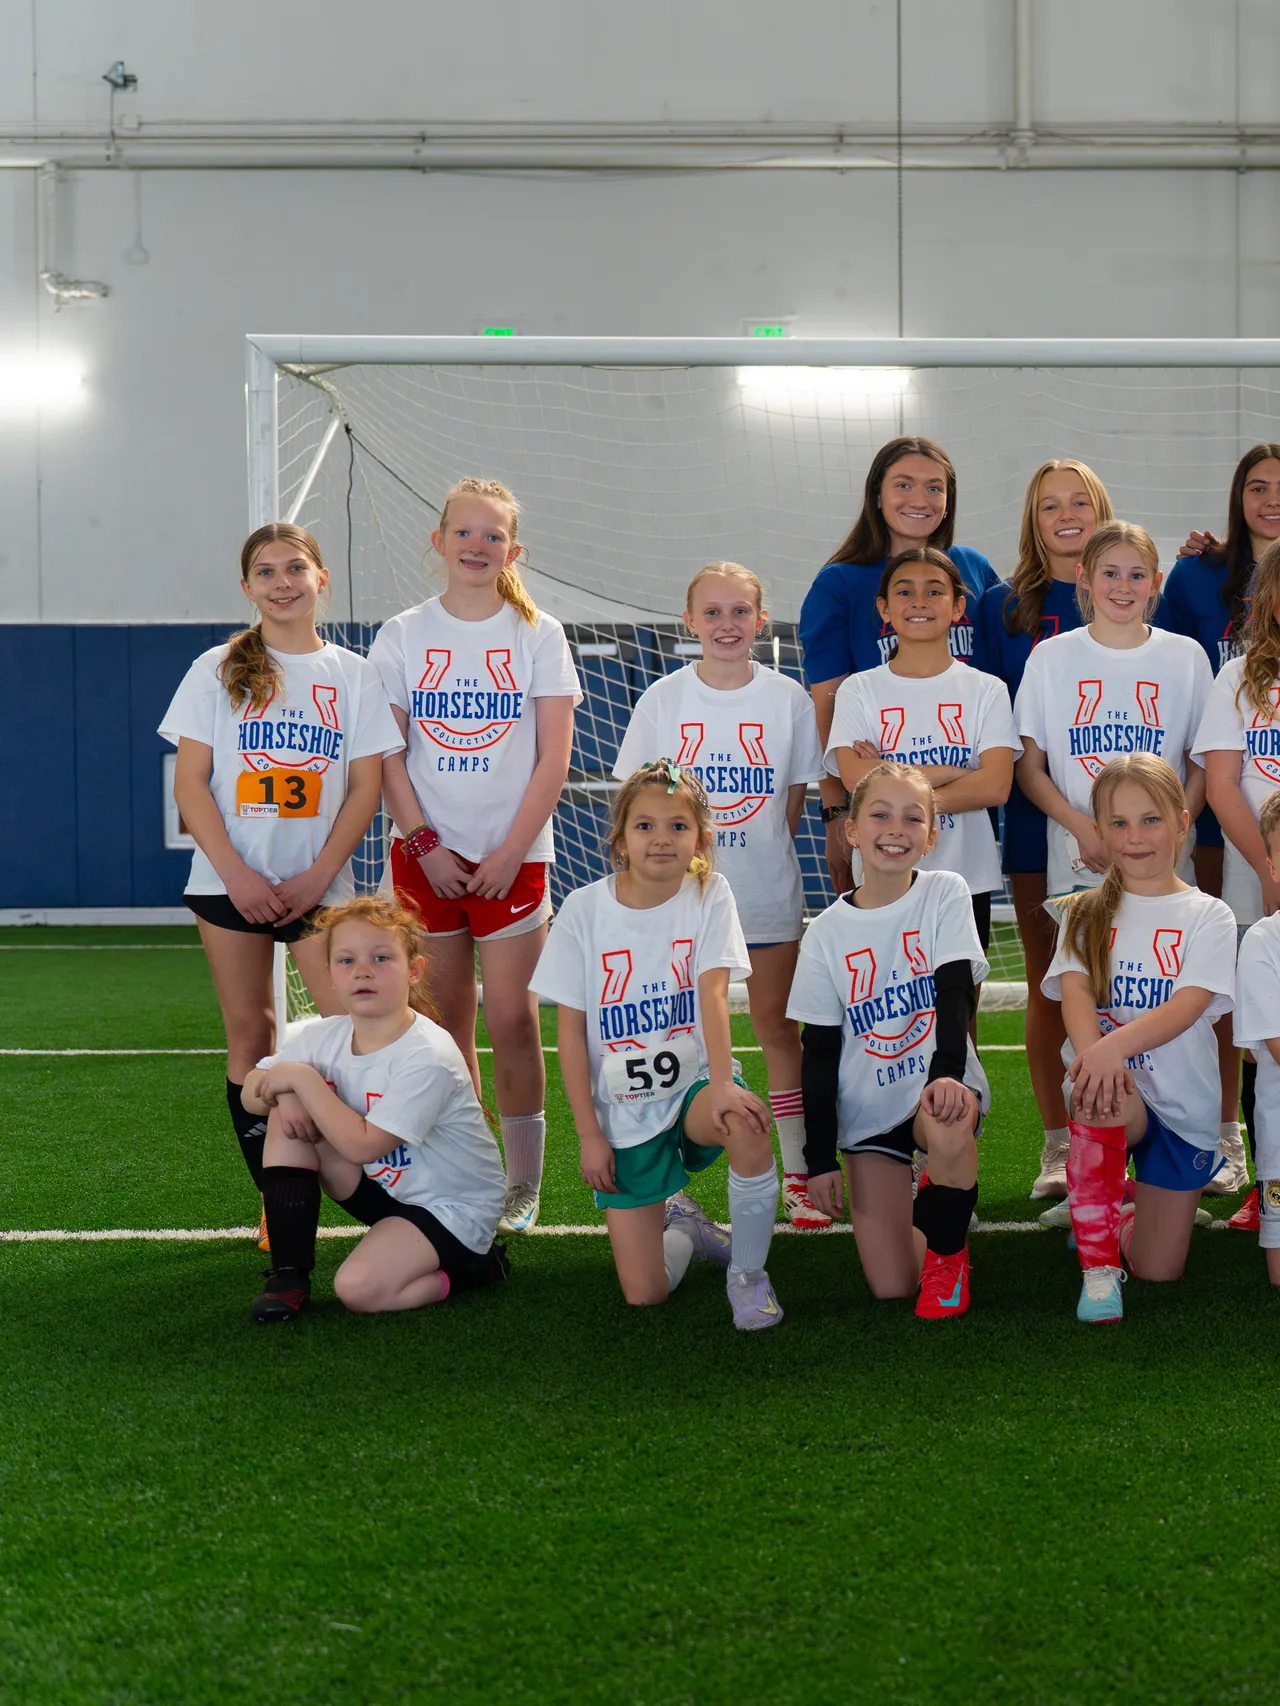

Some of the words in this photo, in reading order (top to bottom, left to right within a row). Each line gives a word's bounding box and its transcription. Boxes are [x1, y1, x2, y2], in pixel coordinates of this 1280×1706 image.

[456, 678, 478, 687] THE
[281, 708, 305, 719] THE
[411, 690, 523, 720] HORSESHOE
[1107, 710, 1128, 720] THE
[238, 720, 344, 761] HORSESHOE
[432, 726, 500, 745] COLLECTIVE
[911, 735, 932, 746] THE
[1068, 723, 1165, 757] HORSESHOE
[437, 756, 490, 772] CAMPS
[709, 753, 732, 762] THE
[257, 775, 307, 810] 13
[715, 802, 754, 820] ECTIVE
[717, 831, 746, 848] MPS
[1119, 960, 1143, 972] THE
[642, 981, 667, 994] THE
[1097, 975, 1174, 1010] SESHO
[869, 1019, 928, 1052] OLLECTIVE
[625, 1050, 681, 1092] 59
[876, 1055, 926, 1087] CAMPS
